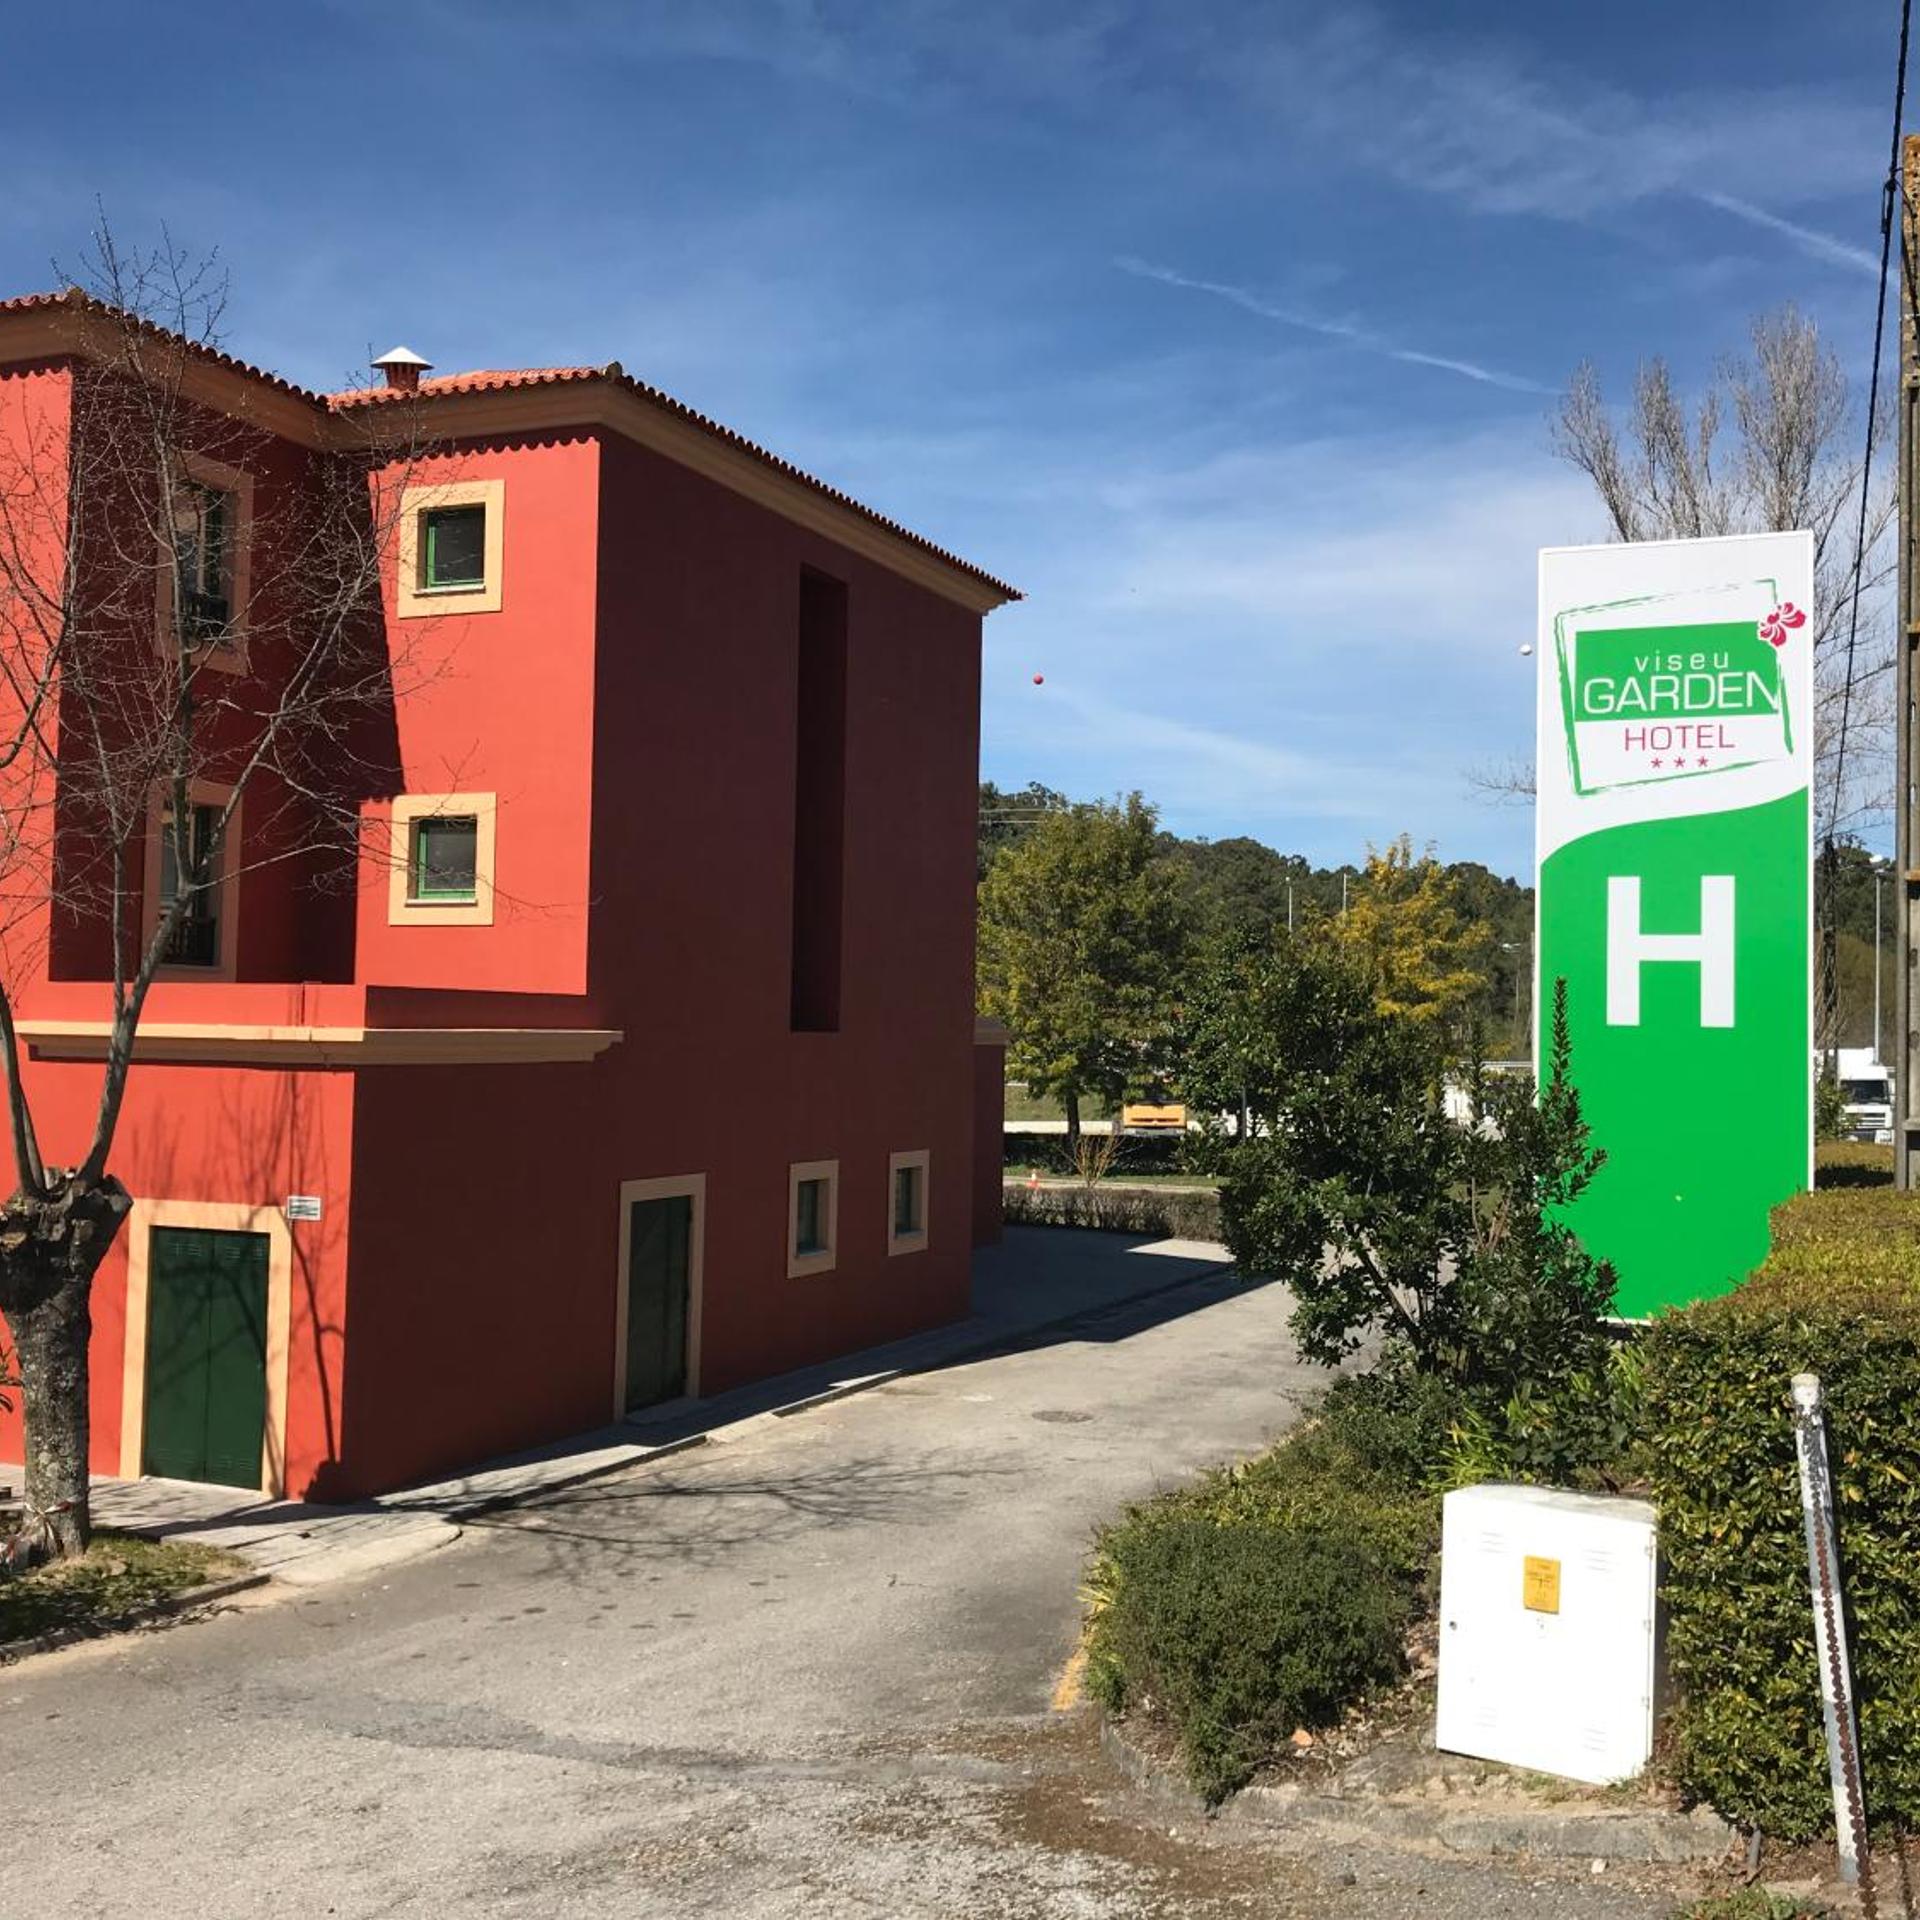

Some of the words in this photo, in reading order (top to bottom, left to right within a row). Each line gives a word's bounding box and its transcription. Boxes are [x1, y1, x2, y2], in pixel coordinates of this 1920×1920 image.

[1634, 650, 1729, 672] viseu
[1583, 671, 1780, 714] GARDEN
[1624, 724, 1736, 751] HOTEL
[1606, 875, 1736, 1028] H
